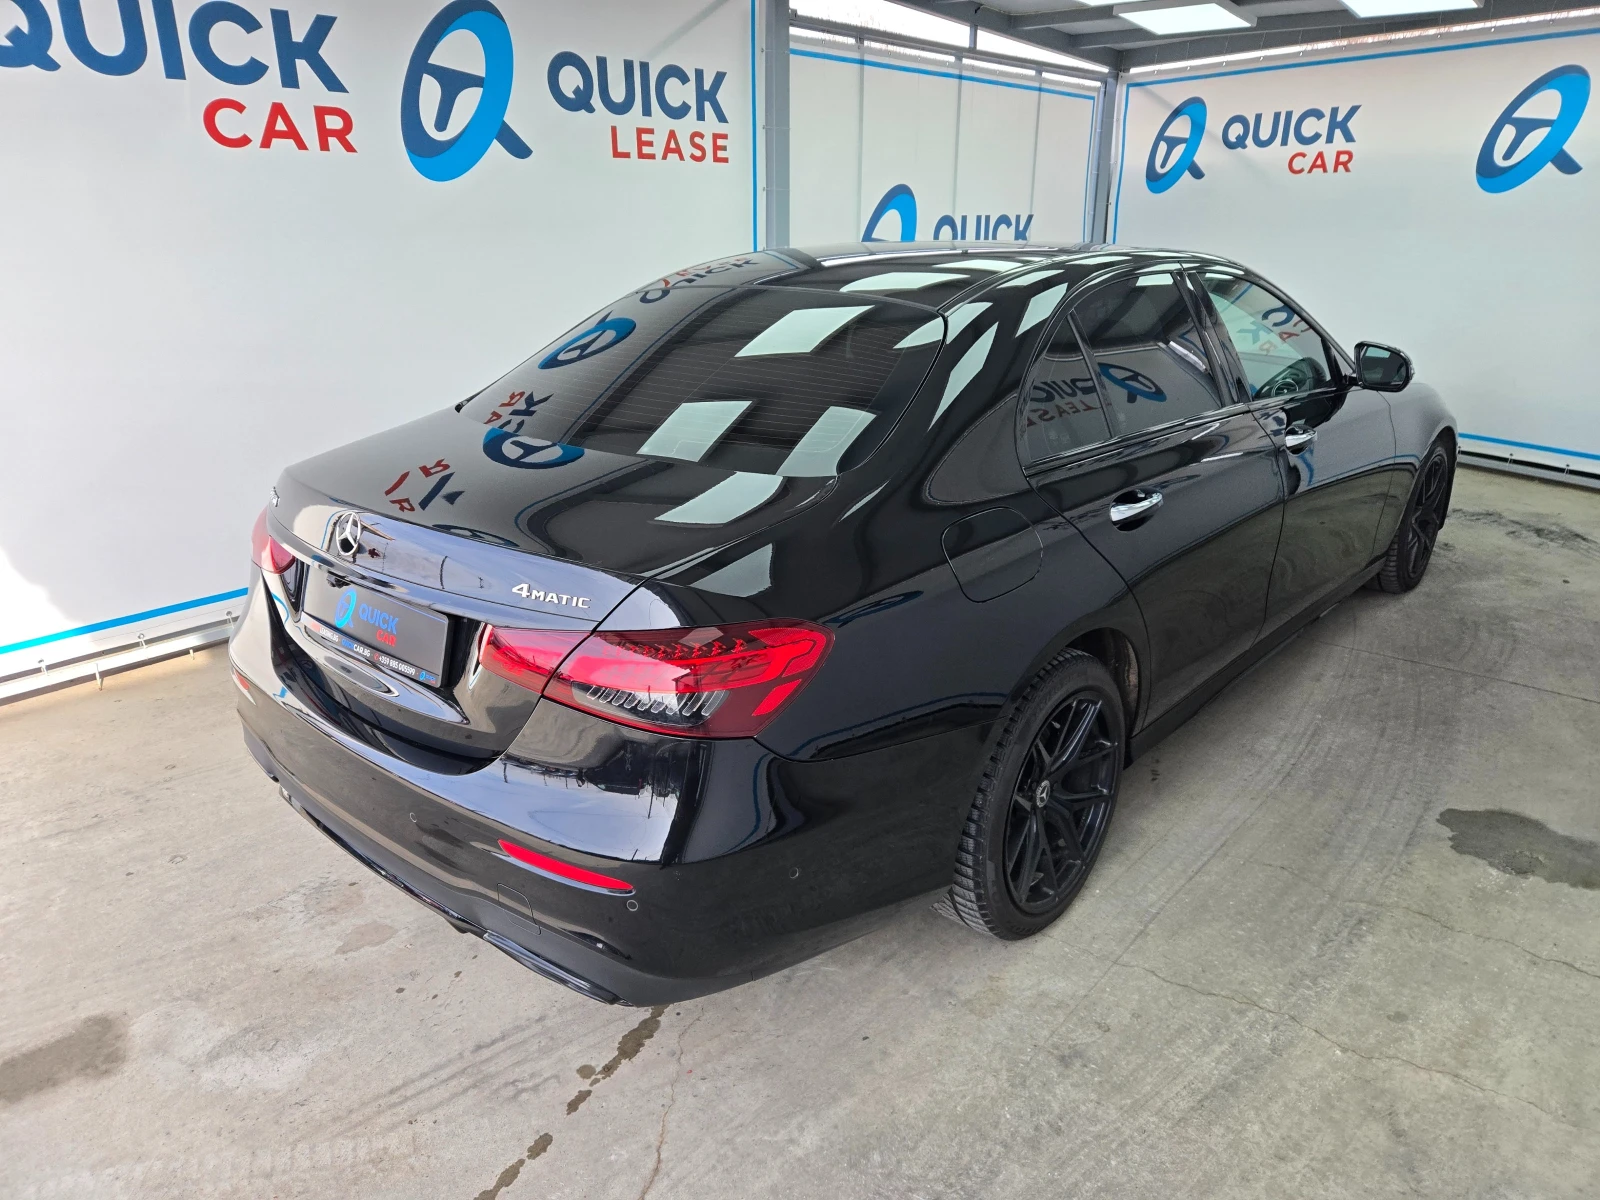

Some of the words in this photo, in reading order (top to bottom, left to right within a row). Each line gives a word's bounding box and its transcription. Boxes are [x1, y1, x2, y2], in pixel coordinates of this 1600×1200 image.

[547, 51, 729, 124] QUICK
[203, 98, 358, 153] CAR
[1222, 104, 1362, 150] QUICK
[610, 125, 729, 164] LEASE
[1287, 149, 1354, 175] CAR
[511, 583, 592, 609] 4MATIC
[358, 603, 399, 635] QUICK
[376, 629, 397, 647] CAR
